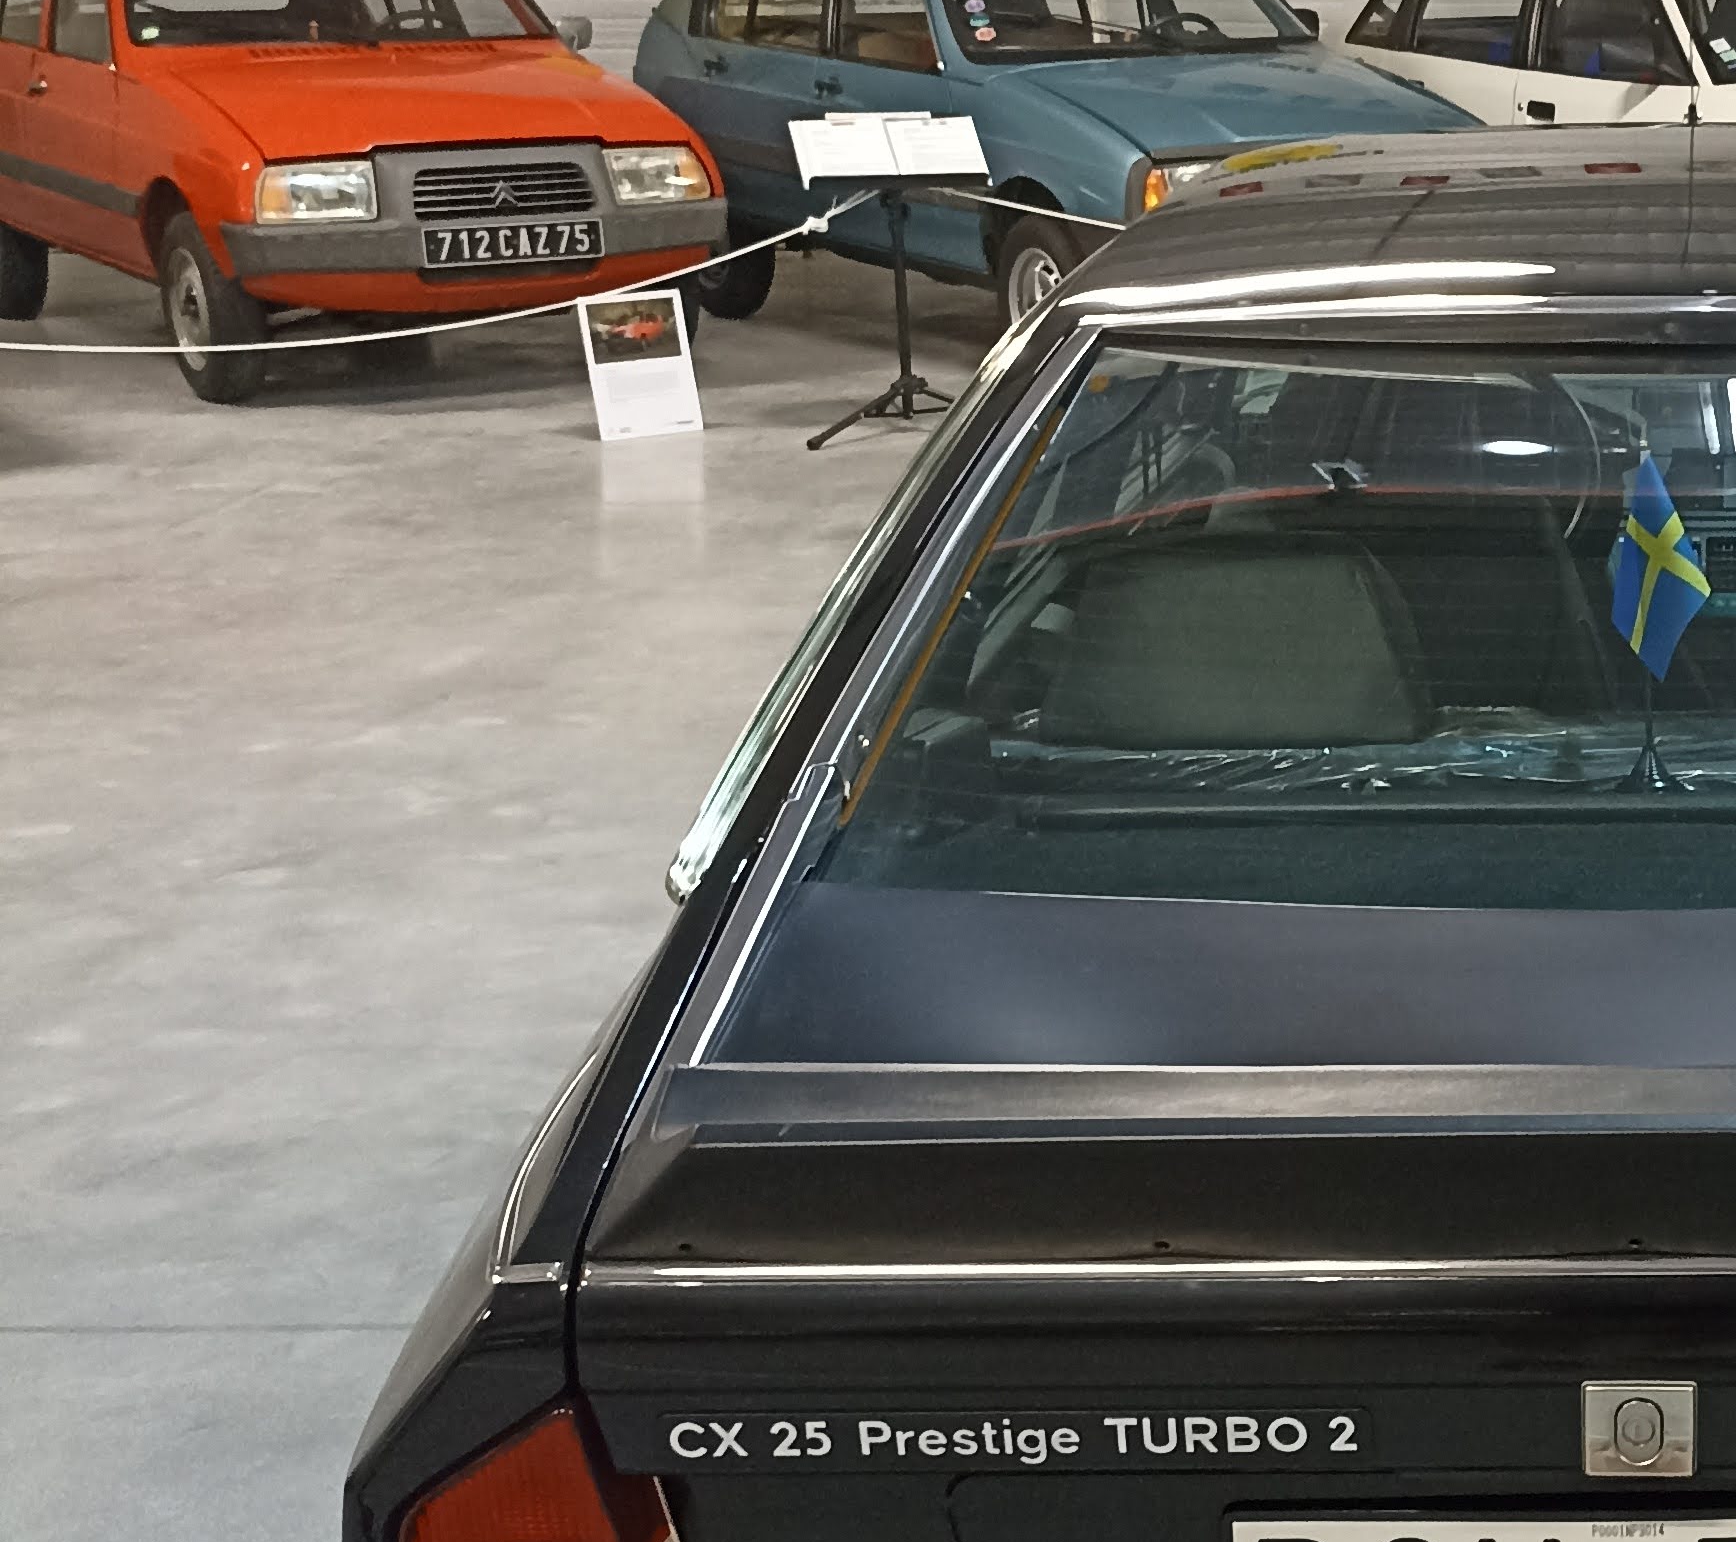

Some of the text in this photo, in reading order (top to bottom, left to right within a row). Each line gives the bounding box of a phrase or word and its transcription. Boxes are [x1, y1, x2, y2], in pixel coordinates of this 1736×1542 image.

[669, 1415, 1358, 1463] CX 25 Prestige TURBO 2
